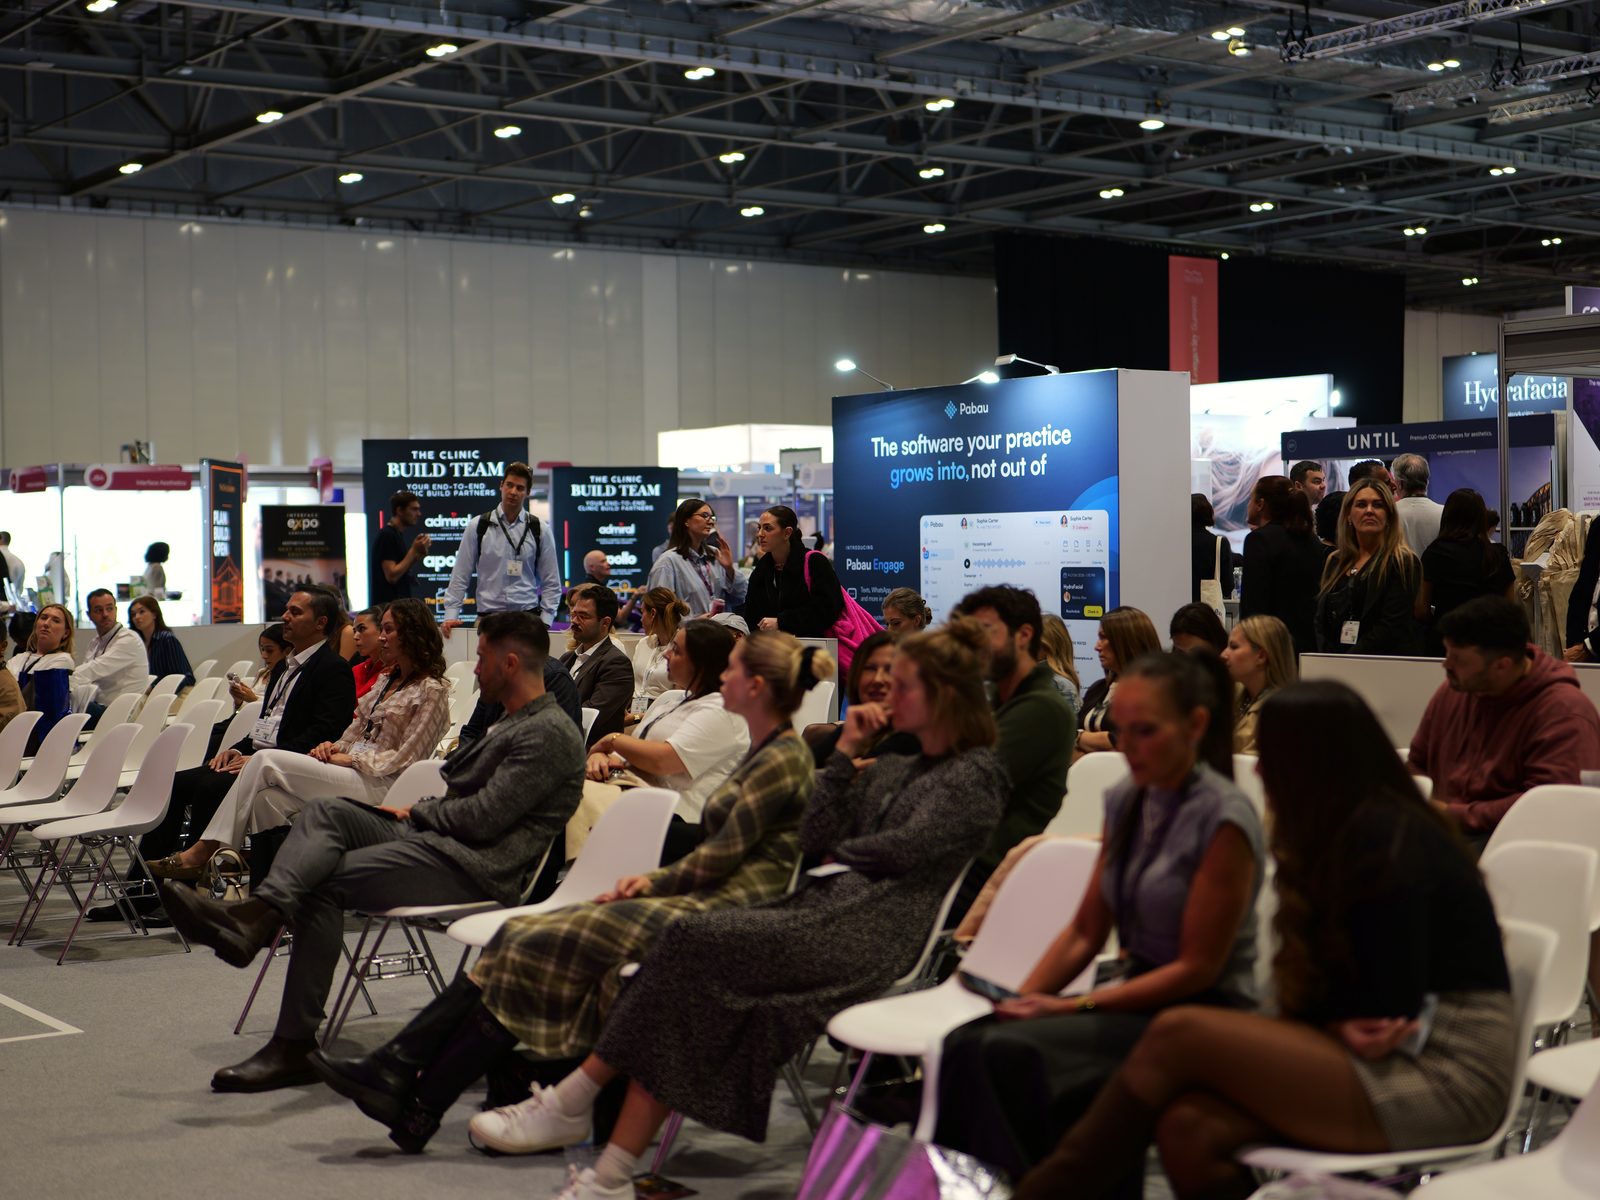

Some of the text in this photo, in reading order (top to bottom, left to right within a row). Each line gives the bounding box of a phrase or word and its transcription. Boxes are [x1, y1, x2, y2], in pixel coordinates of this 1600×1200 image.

[959, 402, 989, 415] Pabau
[871, 424, 1072, 457] The software your practice
[1347, 432, 1400, 450] UNTIL
[411, 450, 480, 460] THE CLINIC
[387, 461, 505, 478] BUILD TEAM
[890, 453, 1048, 489] grows into, not out of
[590, 475, 642, 484] THE CLINIC
[406, 482, 486, 491] YOUR END-TO-END
[426, 490, 452, 498] BUILD
[453, 488, 496, 497] PARTNERS
[571, 483, 661, 497] BUILD TEAM
[585, 499, 647, 507] YOUR END-TO-END
[287, 518, 319, 531] expo
[424, 513, 473, 528] admiral
[598, 522, 635, 535] admiral
[422, 551, 459, 572] apo
[846, 559, 905, 574] Pabau Engage
